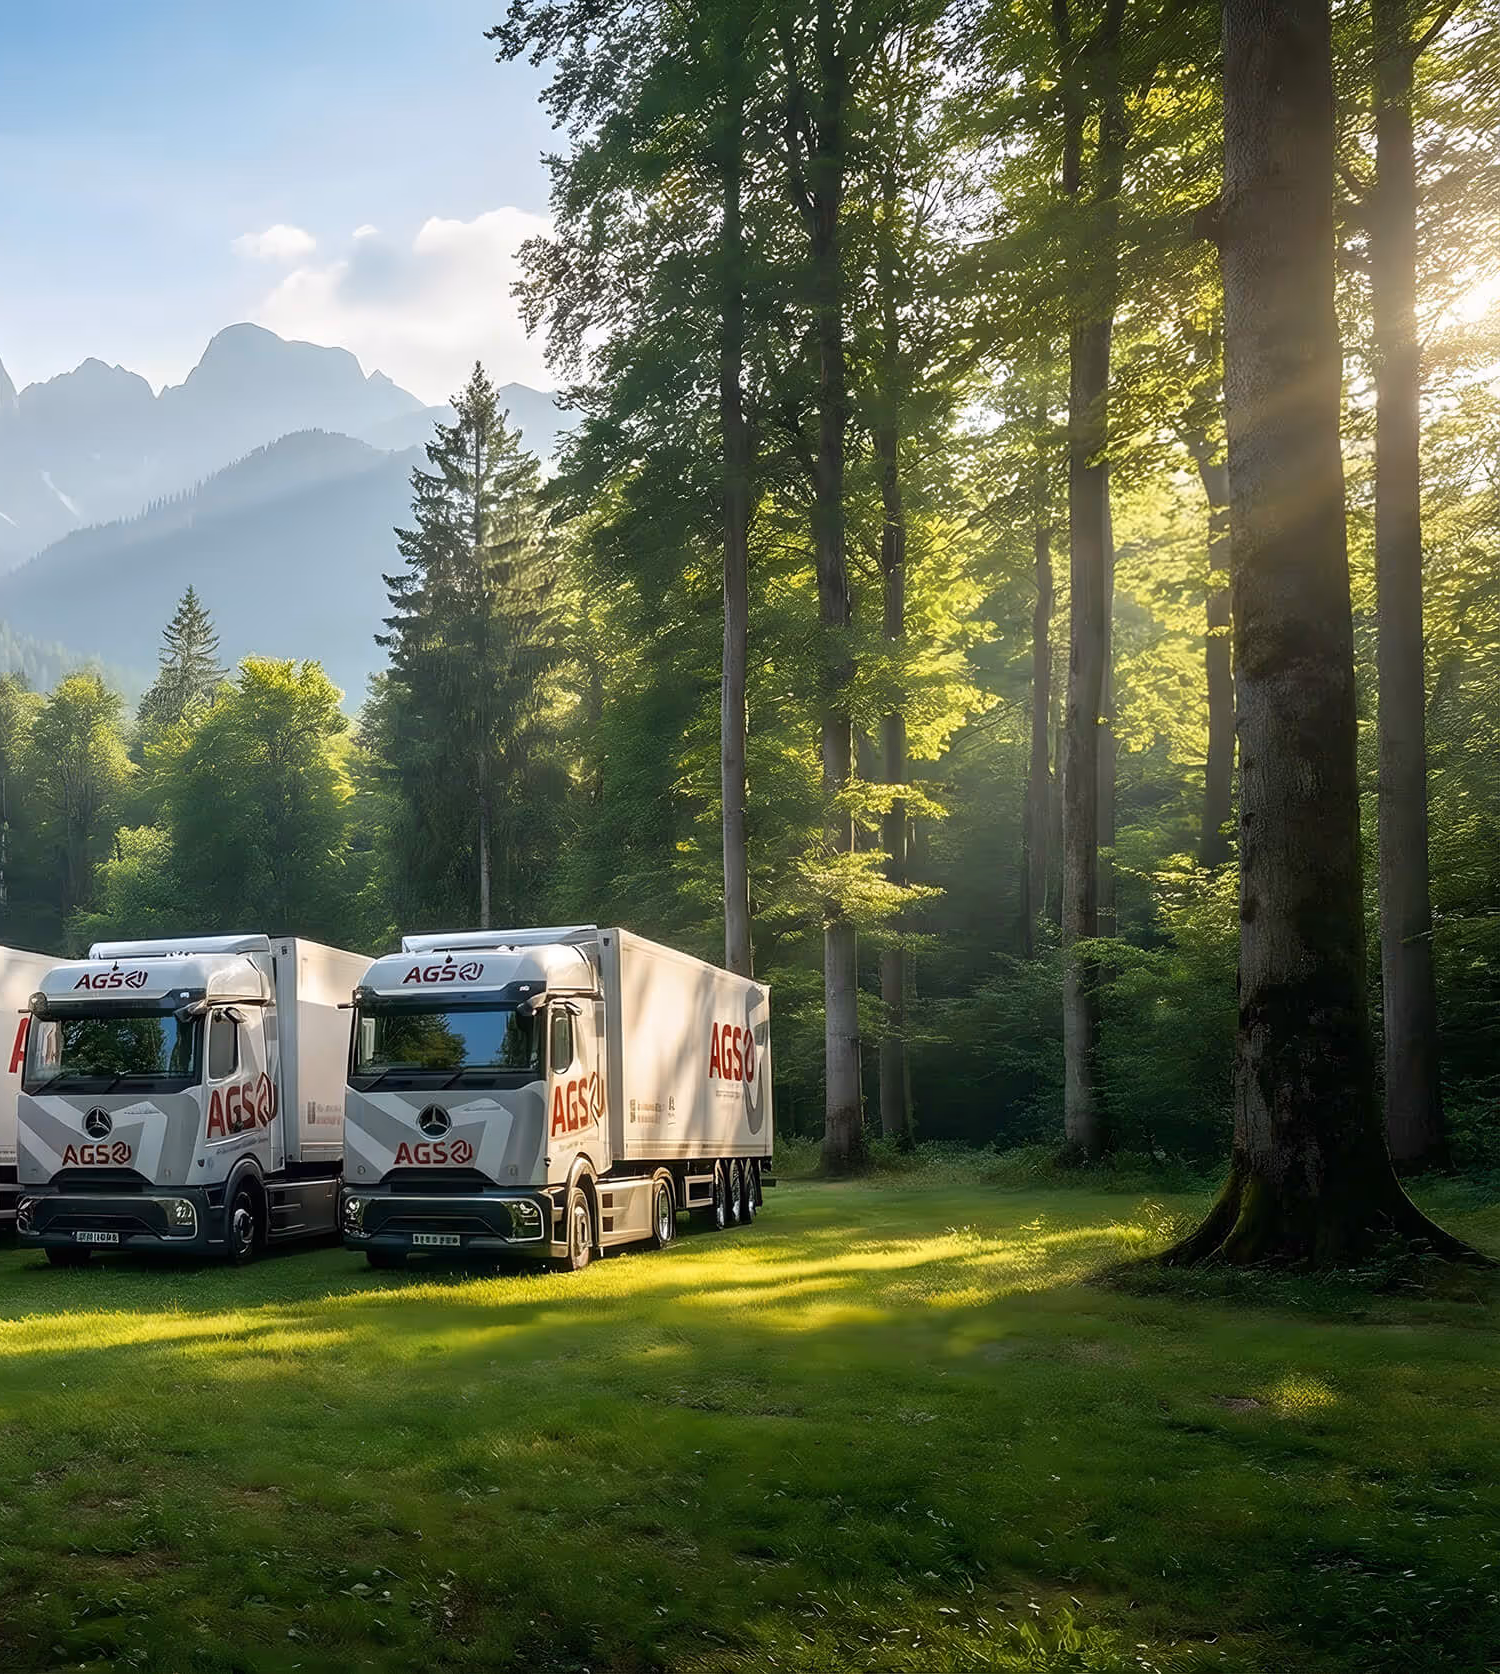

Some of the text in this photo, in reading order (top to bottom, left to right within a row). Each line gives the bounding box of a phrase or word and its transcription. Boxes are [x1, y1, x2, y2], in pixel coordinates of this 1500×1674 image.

[74, 973, 120, 990] AGS
[402, 965, 458, 983] AGS
[709, 1022, 743, 1081] AGS
[207, 1083, 255, 1138] AGS
[551, 1078, 588, 1137] AGS
[62, 1144, 109, 1166] AGS
[394, 1142, 448, 1165] AGS
